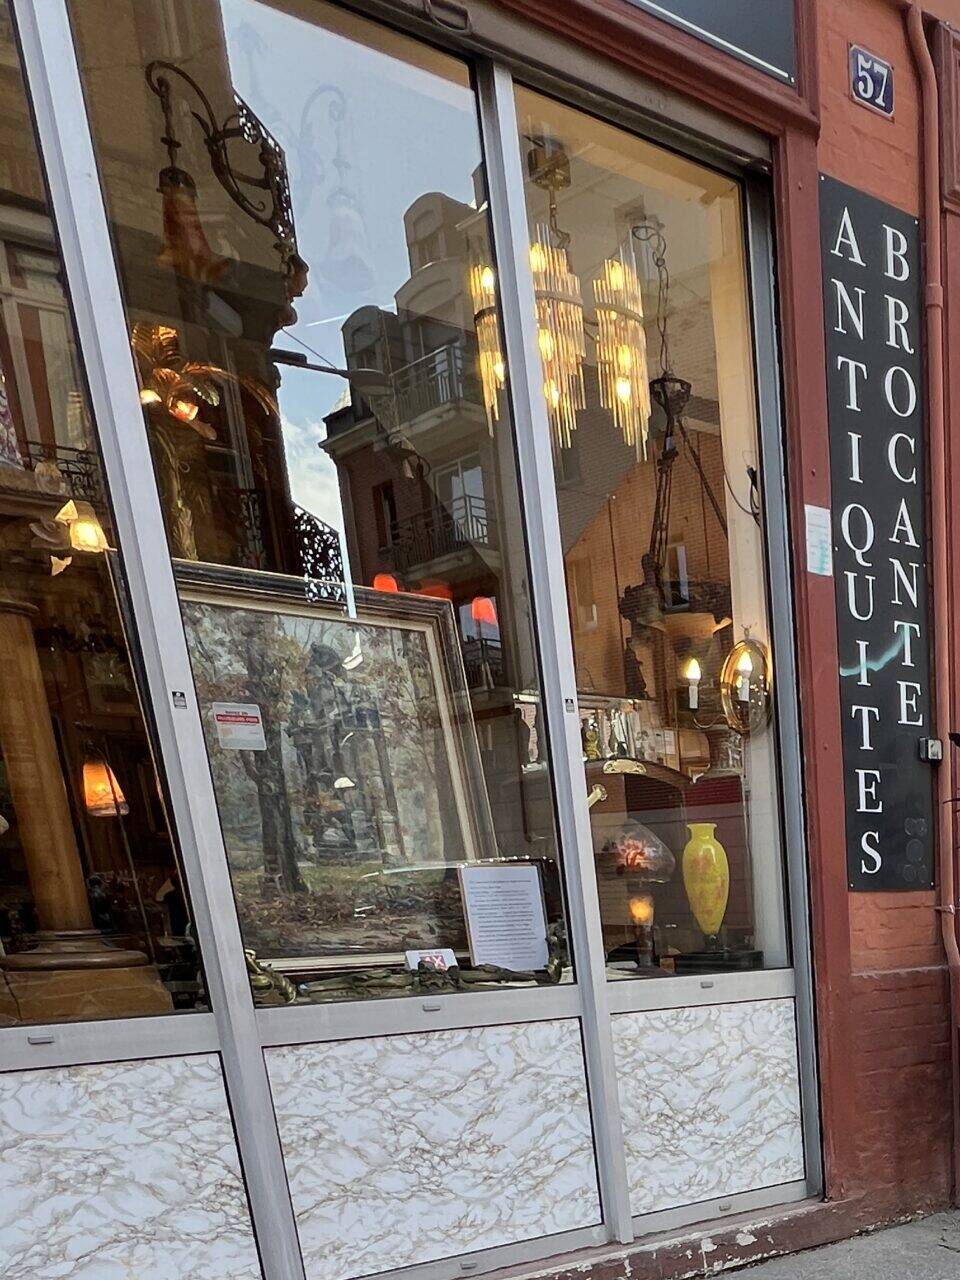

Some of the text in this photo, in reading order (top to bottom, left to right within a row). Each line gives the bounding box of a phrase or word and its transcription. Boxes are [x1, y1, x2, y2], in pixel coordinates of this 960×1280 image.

[857, 54, 889, 107] 57
[830, 206, 883, 874] ANTIQUITES
[882, 223, 923, 727] BROCANTE
